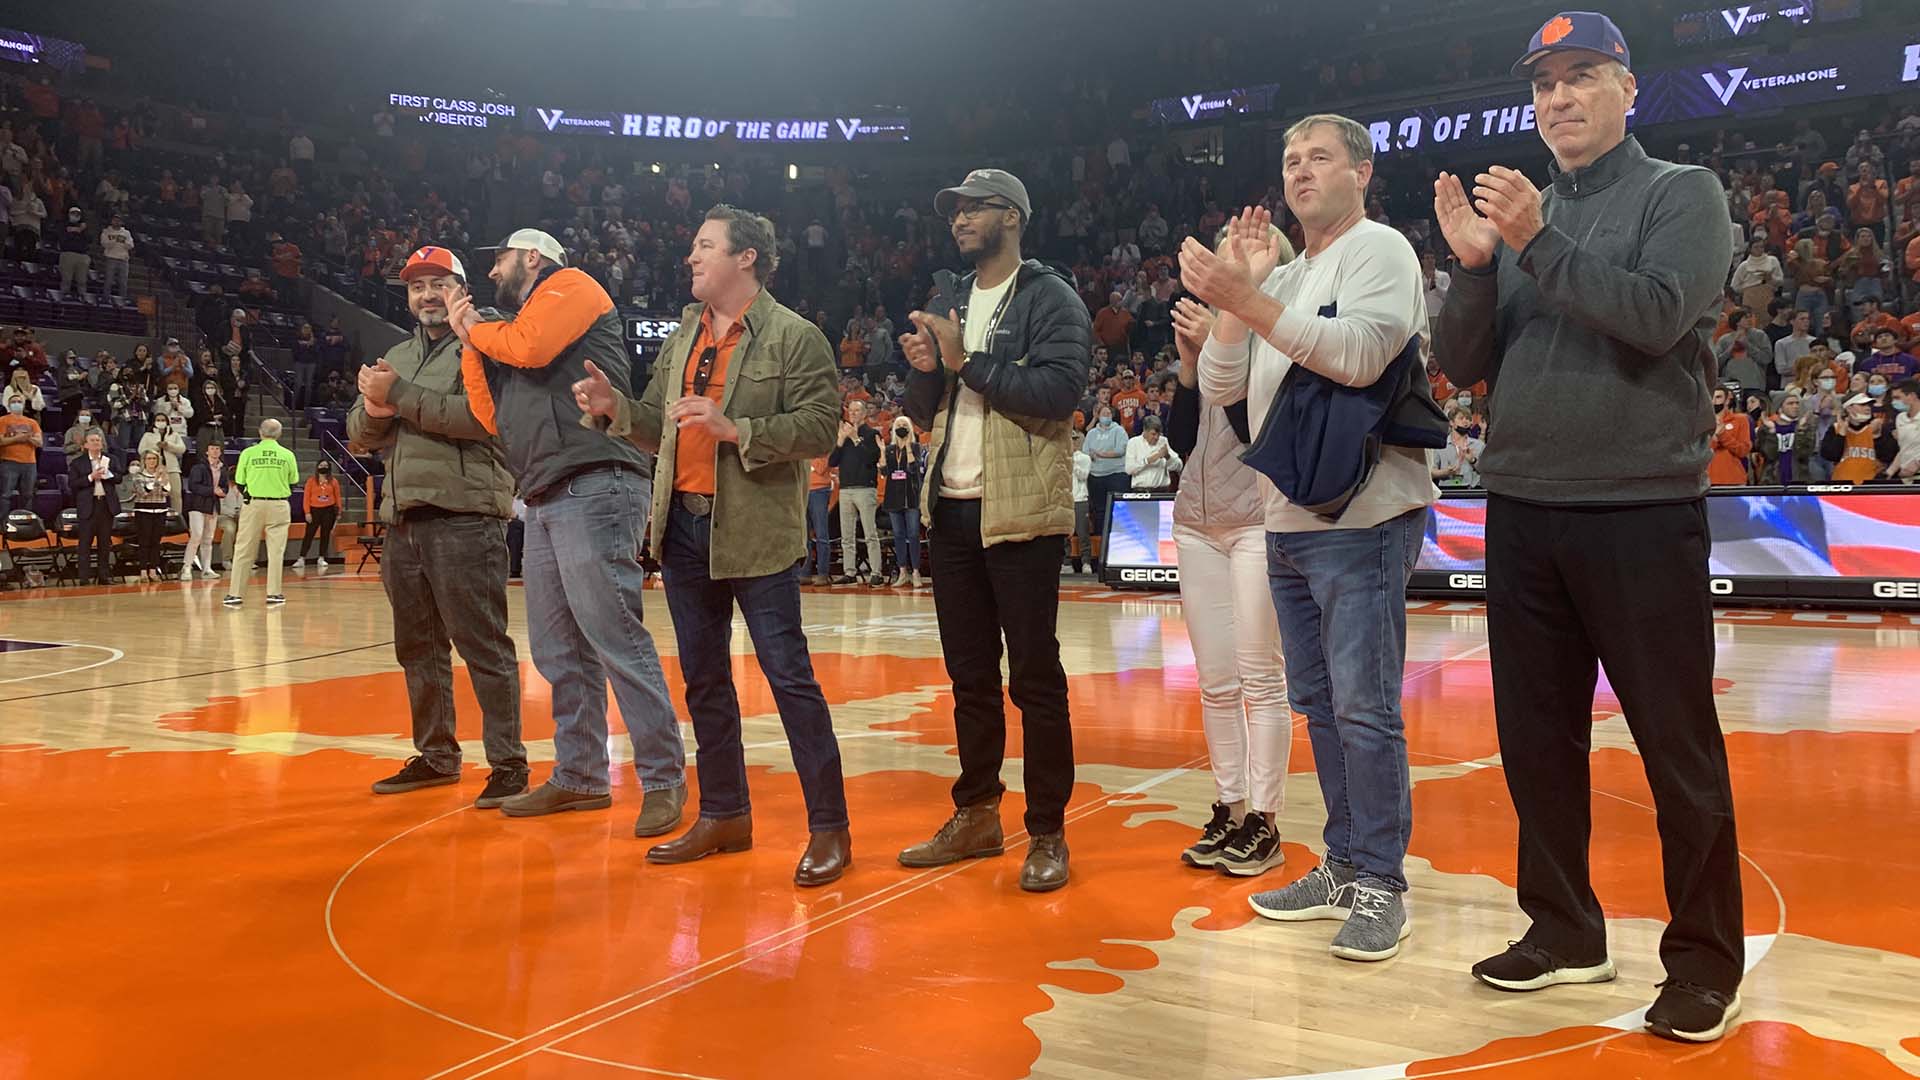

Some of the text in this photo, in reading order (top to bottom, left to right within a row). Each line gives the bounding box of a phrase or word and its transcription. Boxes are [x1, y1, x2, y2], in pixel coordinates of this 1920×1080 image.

[389, 93, 516, 117] FIRST CLASS JOSH
[559, 117, 611, 128] VETERANONE
[622, 113, 702, 139] HERO
[736, 121, 772, 140] THE
[776, 121, 829, 140] GAME
[1368, 104, 1535, 153] RO OF THE
[1121, 569, 1180, 582] GEICO
[1449, 574, 1486, 589] GEI
